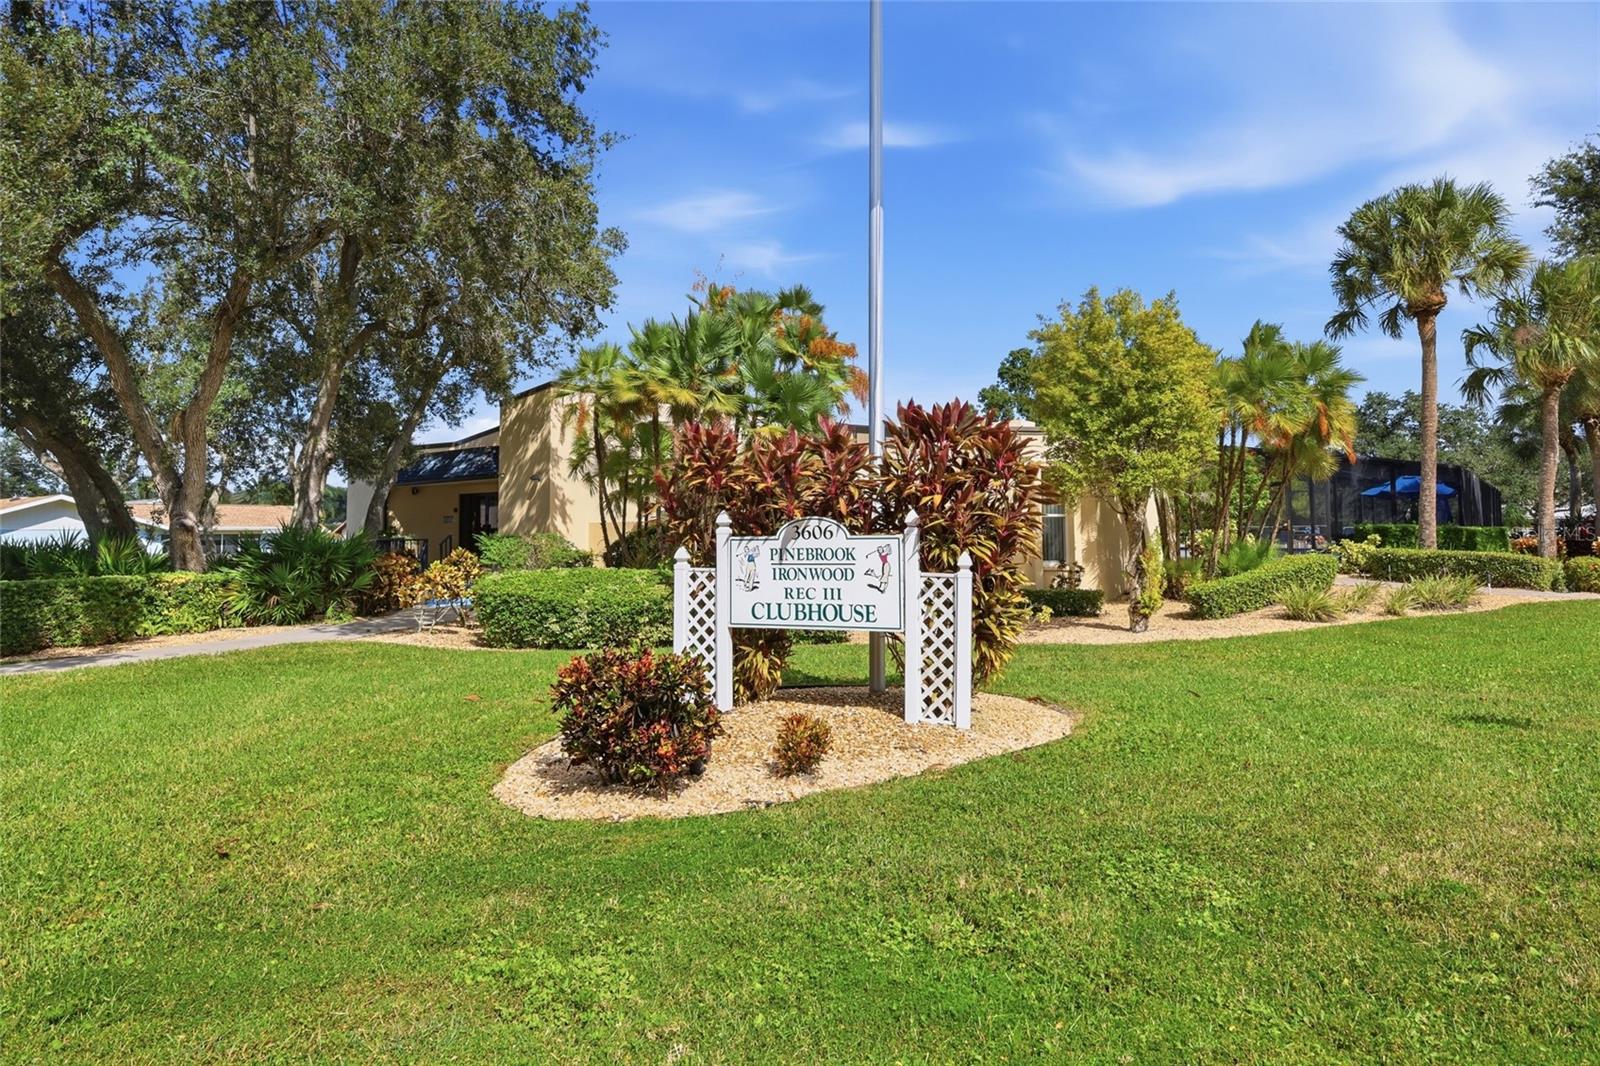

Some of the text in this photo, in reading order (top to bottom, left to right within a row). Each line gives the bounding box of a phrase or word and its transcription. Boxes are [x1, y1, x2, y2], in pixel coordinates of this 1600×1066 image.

[793, 524, 834, 540] 3606
[769, 547, 857, 562] PINEBROOK
[772, 567, 855, 582] IRONWOOD
[784, 587, 842, 600] REC III
[751, 602, 878, 623] CLUBHOUSE
